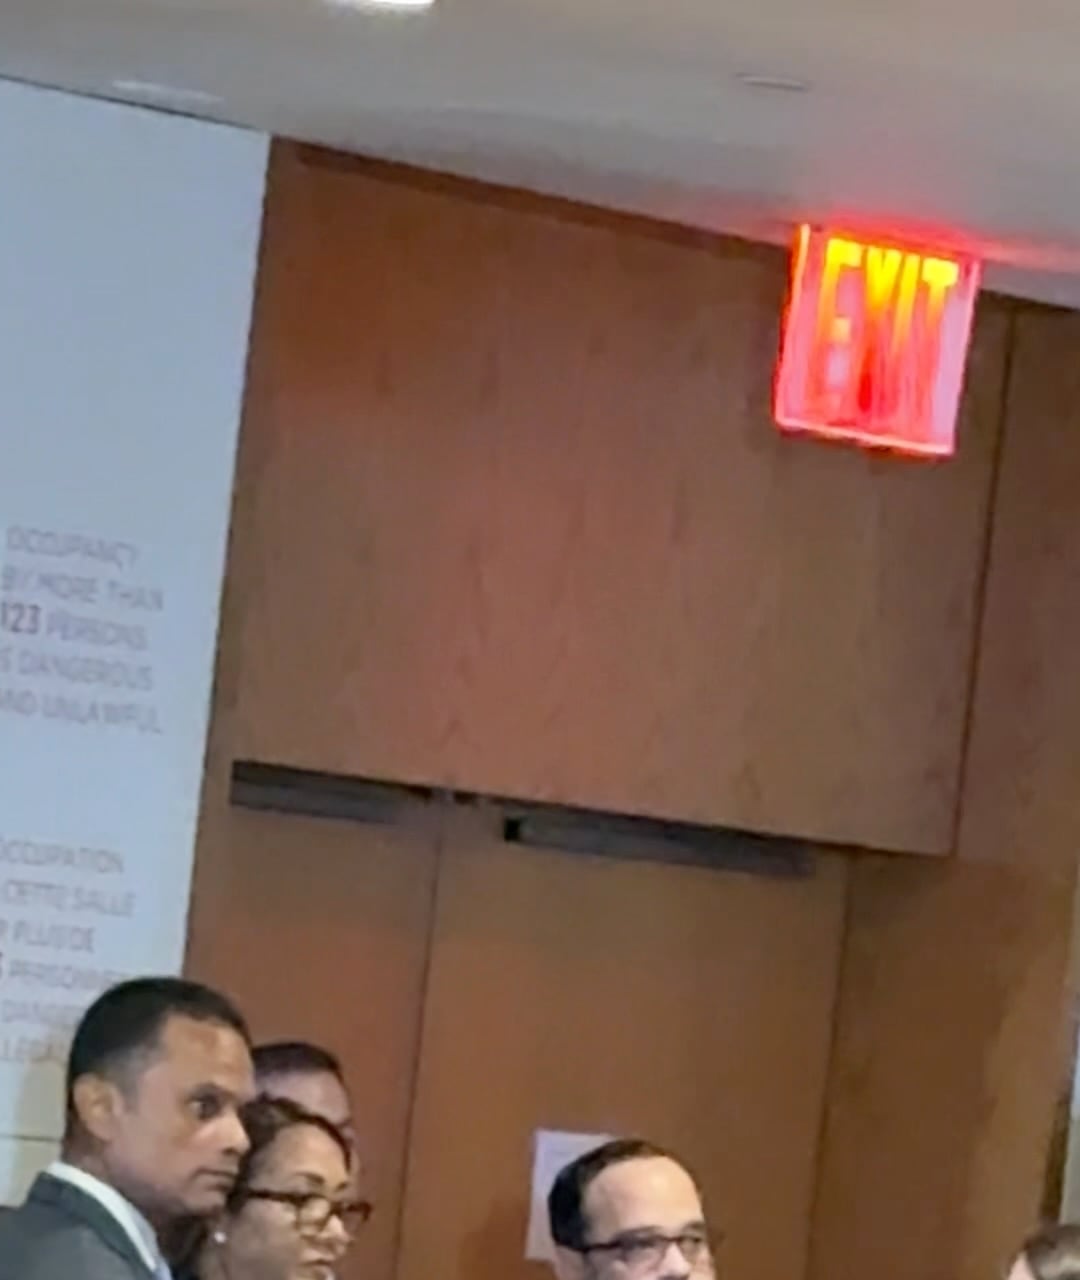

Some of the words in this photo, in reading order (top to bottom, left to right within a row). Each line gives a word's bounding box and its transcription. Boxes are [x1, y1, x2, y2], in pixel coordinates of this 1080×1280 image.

[808, 238, 959, 426] EXIT
[6, 525, 140, 569] OCCUPANCY
[1, 564, 34, 591] BY
[37, 572, 97, 604] MORE
[108, 579, 163, 612] THAN
[0, 600, 41, 635] 123
[47, 609, 149, 651] PERSONS
[17, 649, 154, 692] DANGEROUS
[42, 693, 163, 735] UNLAWFUL
[3, 877, 67, 911] CETTE
[72, 886, 136, 918] SALLE
